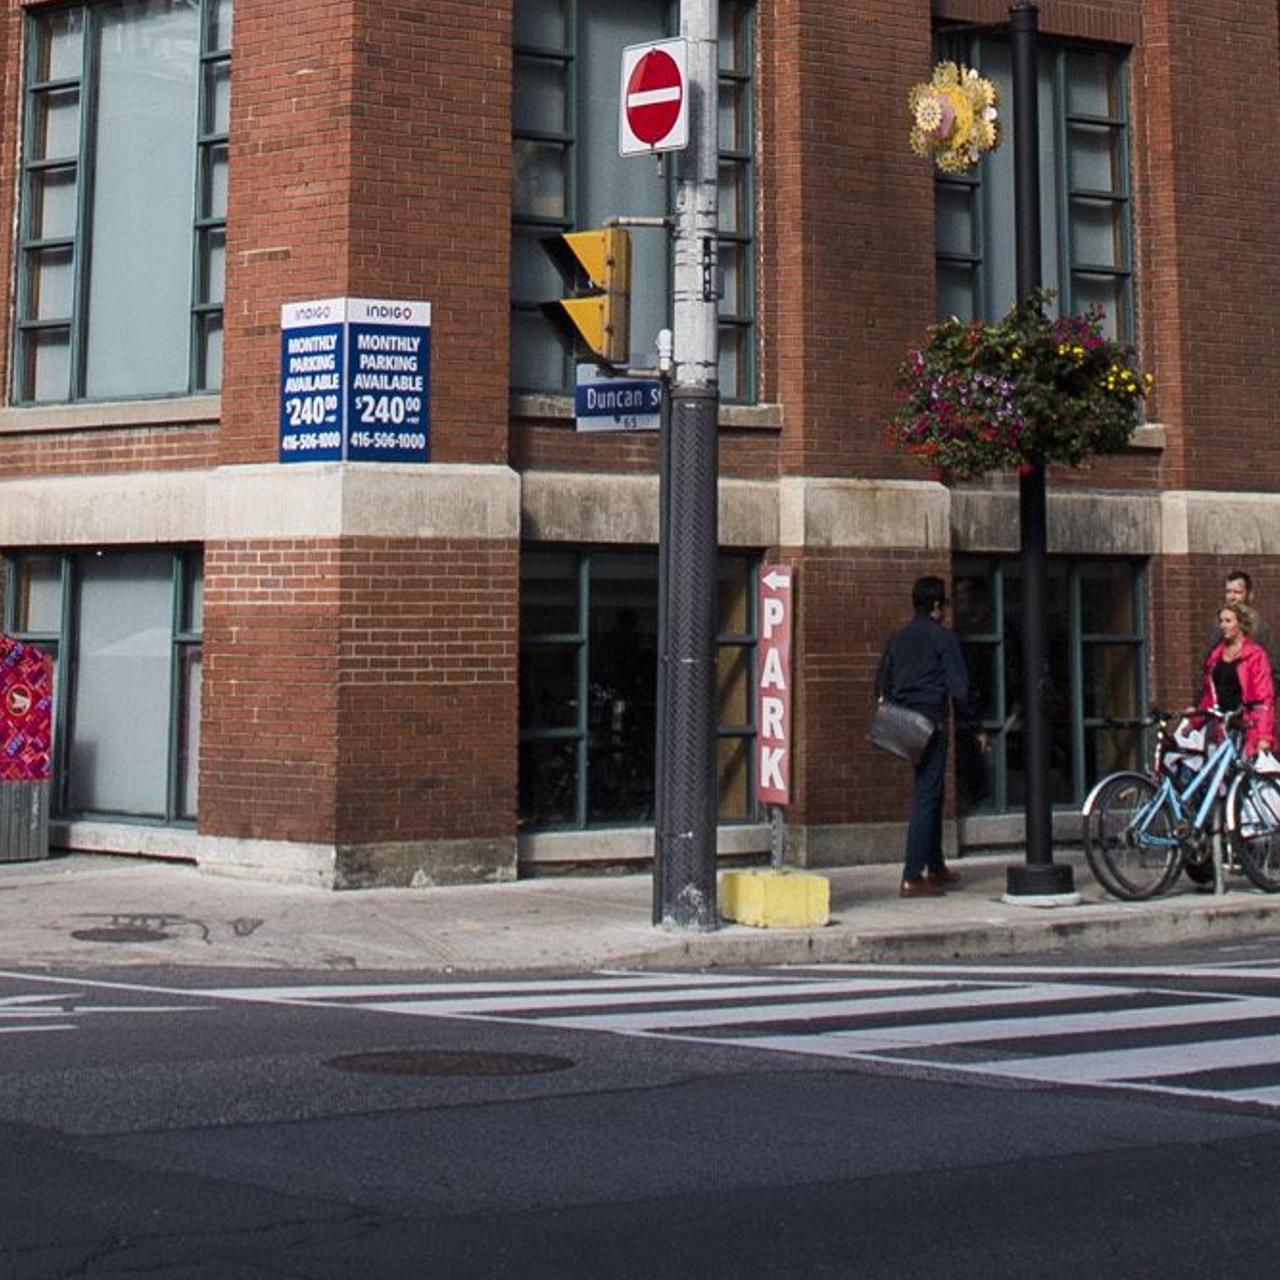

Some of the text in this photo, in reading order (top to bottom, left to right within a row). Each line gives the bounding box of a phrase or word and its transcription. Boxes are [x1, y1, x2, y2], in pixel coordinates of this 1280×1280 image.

[366, 305, 413, 320] INDIGO
[288, 334, 338, 354] MONTHLY
[357, 334, 420, 352] MONTHLY
[289, 354, 336, 374] PARKING
[359, 354, 418, 372] PARKING
[284, 373, 340, 393] AVAILABLE
[353, 373, 423, 391] AVAILABLE
[587, 388, 643, 410] Duncan
[282, 431, 341, 451] 416-506-1000
[350, 432, 426, 450] 416-506-1000
[760, 597, 786, 790] PARK
